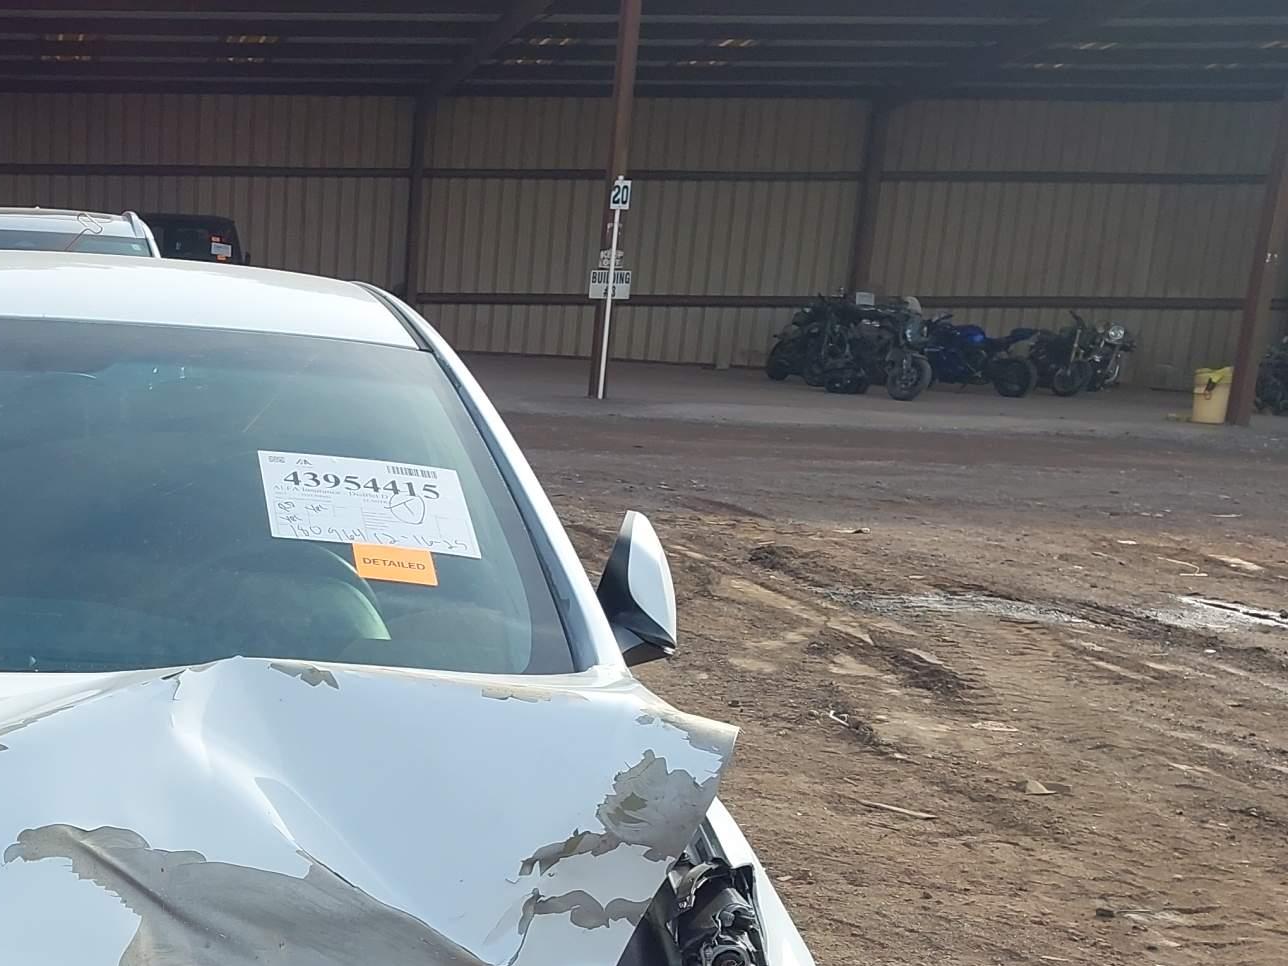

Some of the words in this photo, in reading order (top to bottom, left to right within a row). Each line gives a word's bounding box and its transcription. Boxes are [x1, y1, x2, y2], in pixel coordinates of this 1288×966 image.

[612, 185, 630, 205] 20
[284, 470, 440, 500] 43954415
[362, 556, 426, 571] DETAILED
